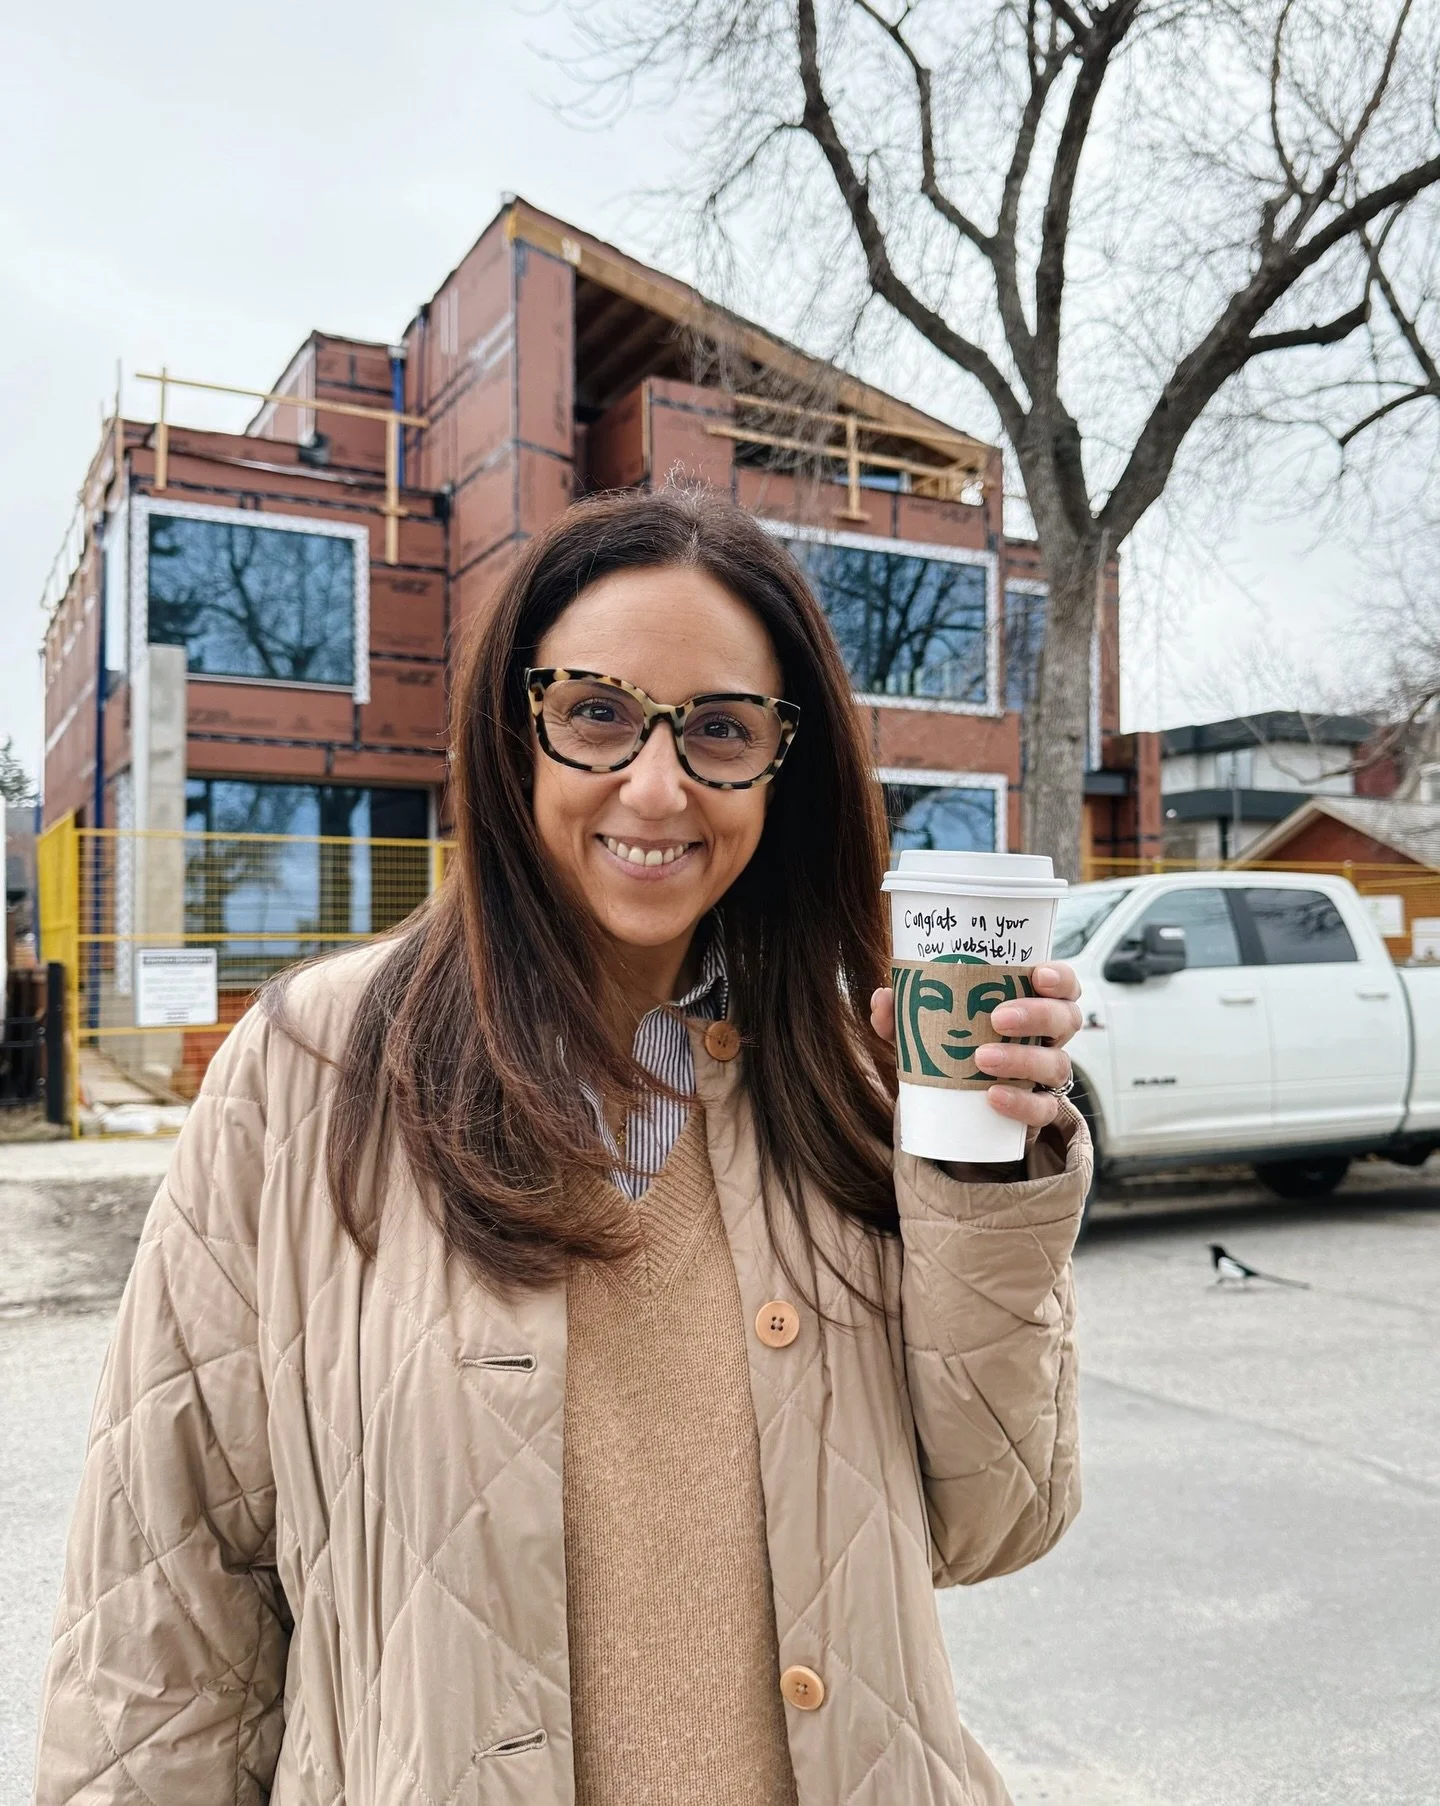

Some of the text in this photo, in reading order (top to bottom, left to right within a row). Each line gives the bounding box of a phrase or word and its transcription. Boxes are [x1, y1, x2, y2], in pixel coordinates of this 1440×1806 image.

[904, 907, 1030, 938] Congrats on your
[917, 941, 944, 958] new
